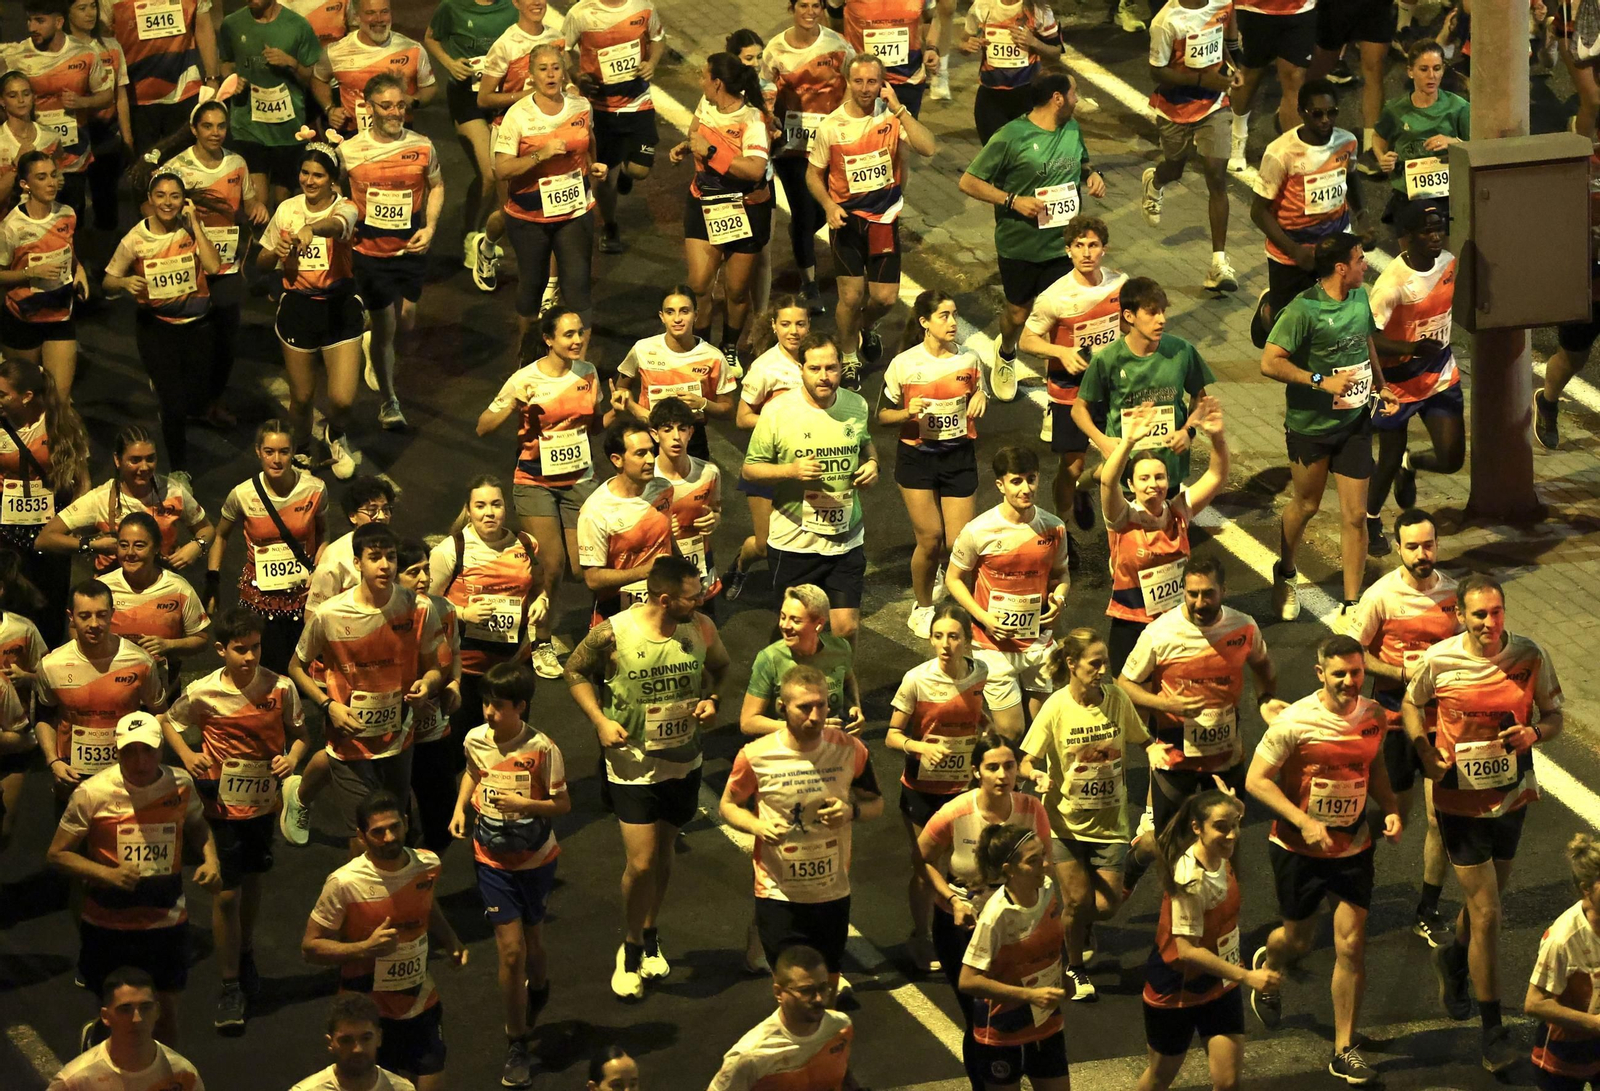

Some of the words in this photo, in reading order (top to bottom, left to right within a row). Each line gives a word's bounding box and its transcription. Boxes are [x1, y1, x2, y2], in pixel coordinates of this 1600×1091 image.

[326, 4, 341, 12] KH7
[146, 14, 174, 28] 5416
[873, 44, 899, 57] 3471
[993, 45, 1020, 57] 5196
[1190, 41, 1219, 57] 24108
[68, 63, 85, 71] KH7
[390, 57, 408, 67] KH7
[609, 58, 637, 73] 1822
[255, 101, 287, 112] 22441
[402, 153, 418, 161] KH7
[853, 165, 887, 182] 20798
[1412, 172, 1449, 188] 19839
[547, 186, 579, 204] 16566
[1311, 185, 1343, 203] 24120
[375, 205, 403, 218] 9284
[709, 217, 743, 233] 13928
[152, 271, 190, 288] 19192
[1079, 330, 1115, 347] 23652
[692, 366, 708, 374] KH7
[956, 374, 970, 383] KH7
[577, 383, 589, 391] KH7
[929, 414, 958, 428] 8596
[550, 446, 581, 462] 8593
[820, 458, 851, 473] ano
[8, 498, 47, 511] 18535
[294, 503, 311, 513] KH7
[813, 509, 843, 522] 1783
[1038, 538, 1053, 547] KH7
[263, 561, 301, 577] 18925
[156, 601, 177, 611] KH7
[115, 673, 135, 684] KH7
[1506, 670, 1530, 681] KH7
[641, 675, 691, 695] sano
[358, 708, 396, 724] 12295
[657, 719, 688, 736] 1816
[1191, 725, 1230, 741] 14959
[1362, 726, 1377, 736] KH7
[1091, 731, 1113, 742] historia
[77, 746, 117, 761] 15338
[1464, 759, 1509, 776] 12608
[227, 777, 269, 793] 17718
[1081, 780, 1114, 795] 4643
[1316, 799, 1357, 814] 11971
[124, 846, 168, 861] 21294
[789, 859, 832, 877] 15361
[387, 957, 421, 978] 4803
